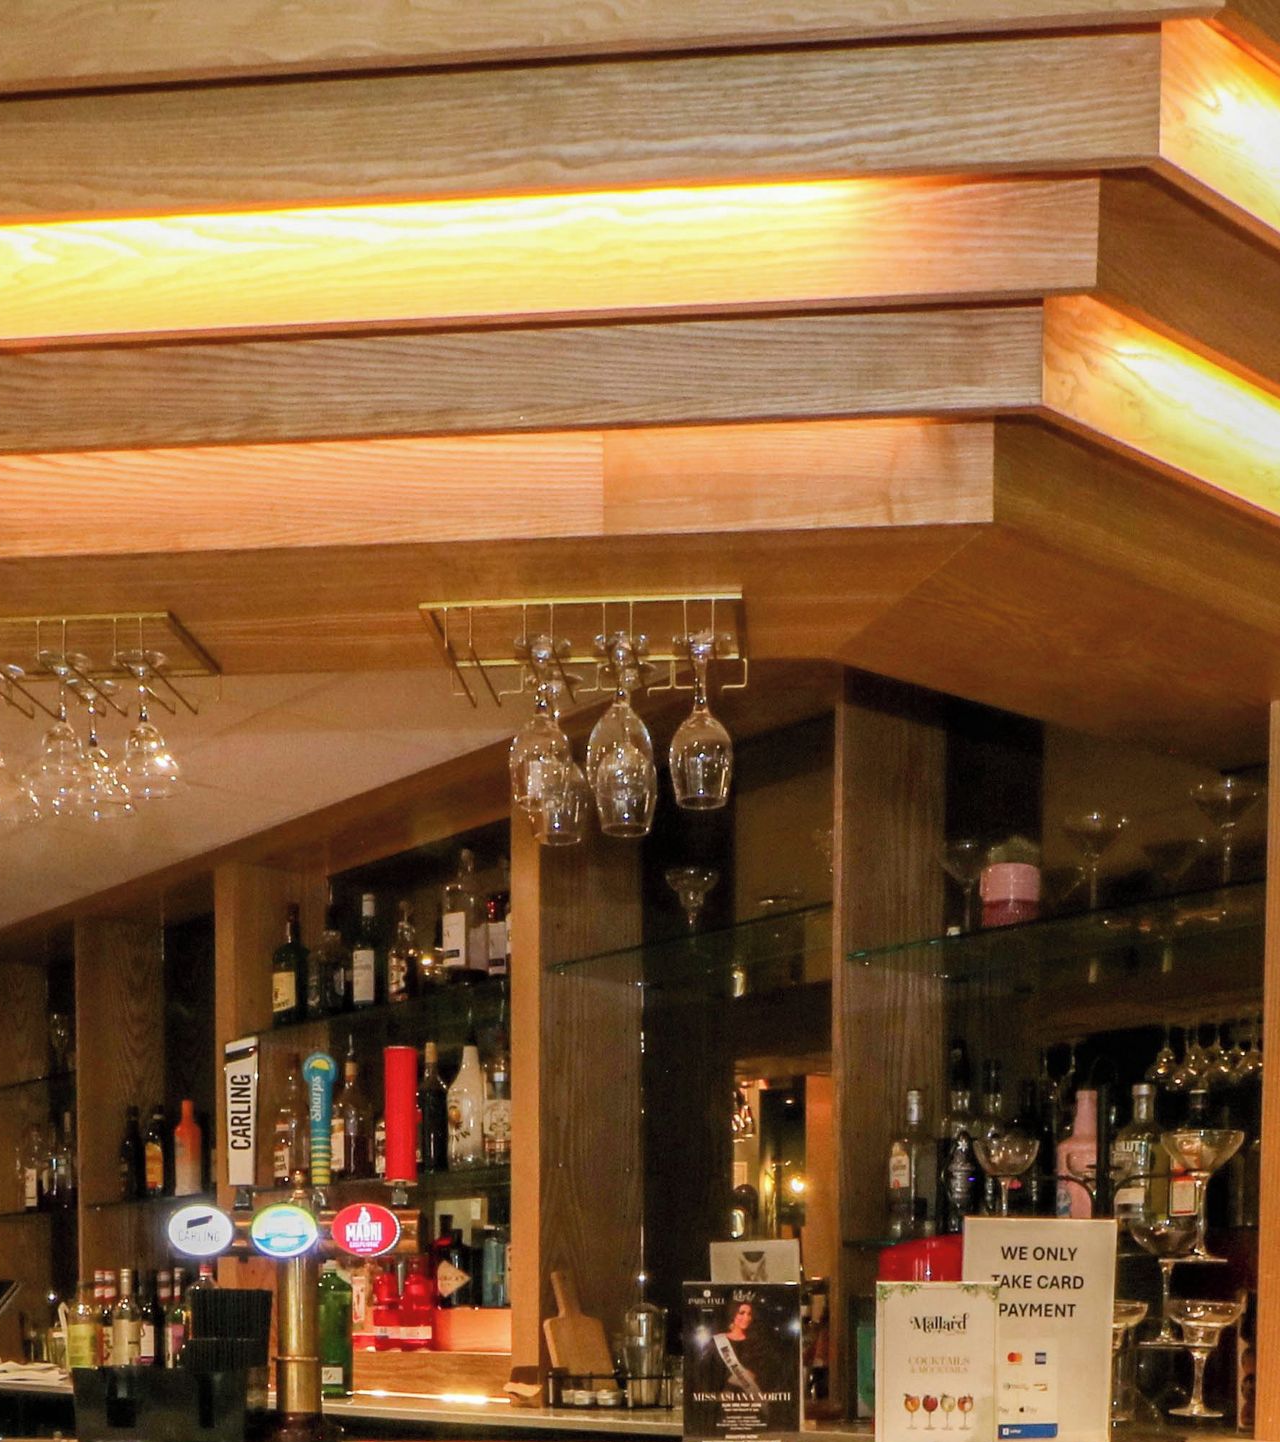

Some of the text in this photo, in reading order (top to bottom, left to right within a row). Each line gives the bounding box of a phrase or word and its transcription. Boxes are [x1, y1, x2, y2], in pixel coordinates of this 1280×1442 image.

[230, 1073, 252, 1151] CARLING
[1001, 1245, 1078, 1262] WE ONLY
[1037, 1275, 1085, 1290] CARD
[998, 1303, 1077, 1318] PAYMENT
[911, 1313, 969, 1333] Mallard
[692, 1391, 717, 1401] MISS
[757, 1391, 791, 1401] NORTH
